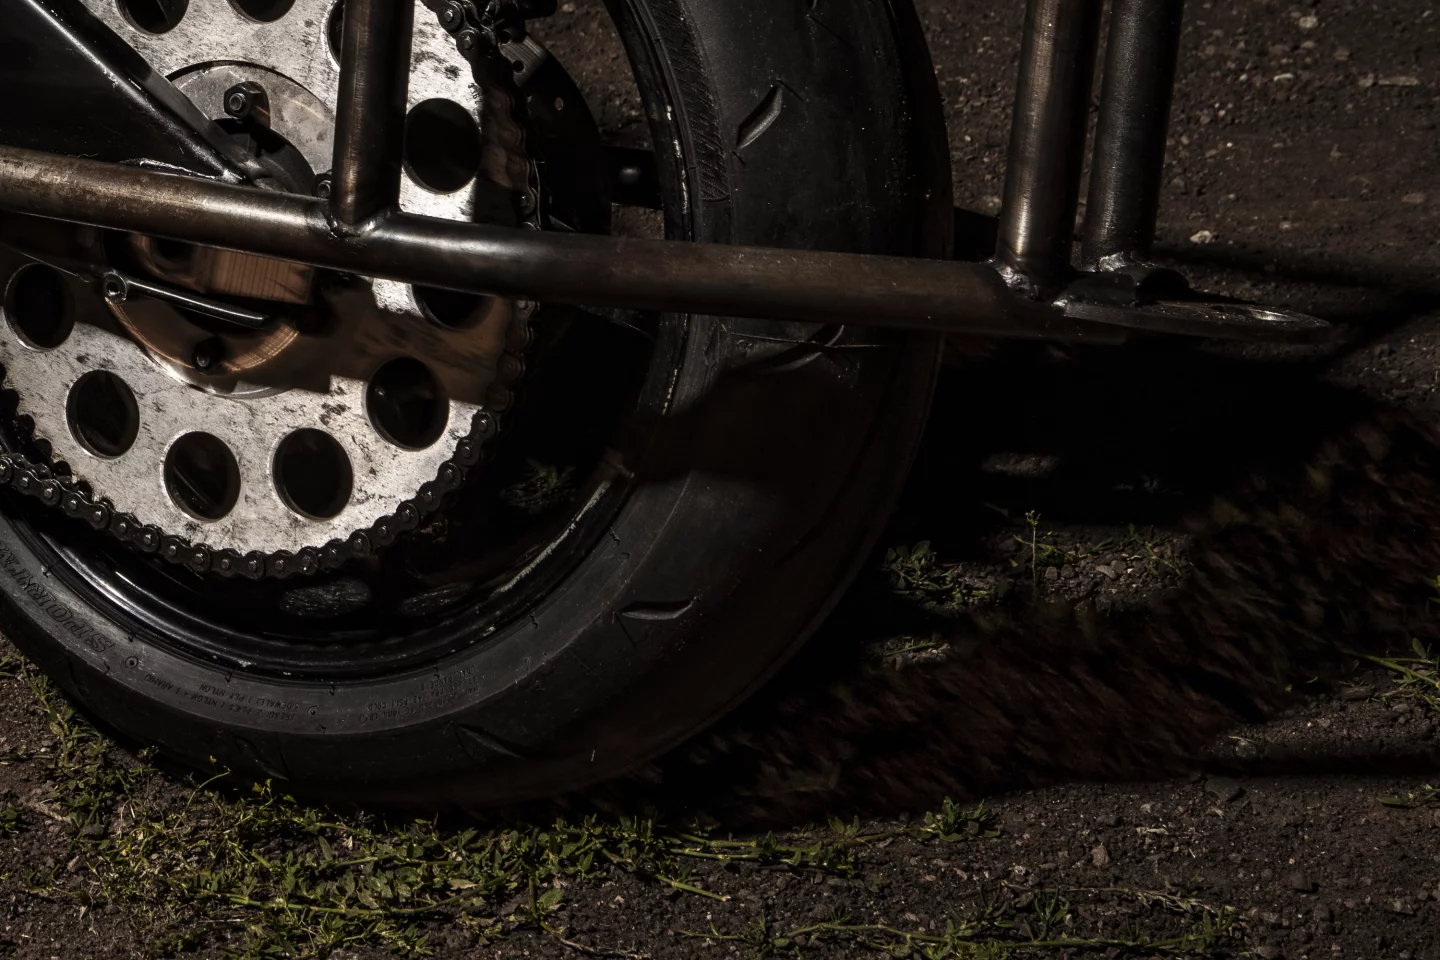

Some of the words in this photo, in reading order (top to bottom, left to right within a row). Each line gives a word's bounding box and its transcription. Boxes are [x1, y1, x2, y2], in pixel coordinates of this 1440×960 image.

[198, 683, 226, 698] NYLON
[255, 697, 301, 710] SIDEWALL:
[367, 702, 388, 712] COLD
